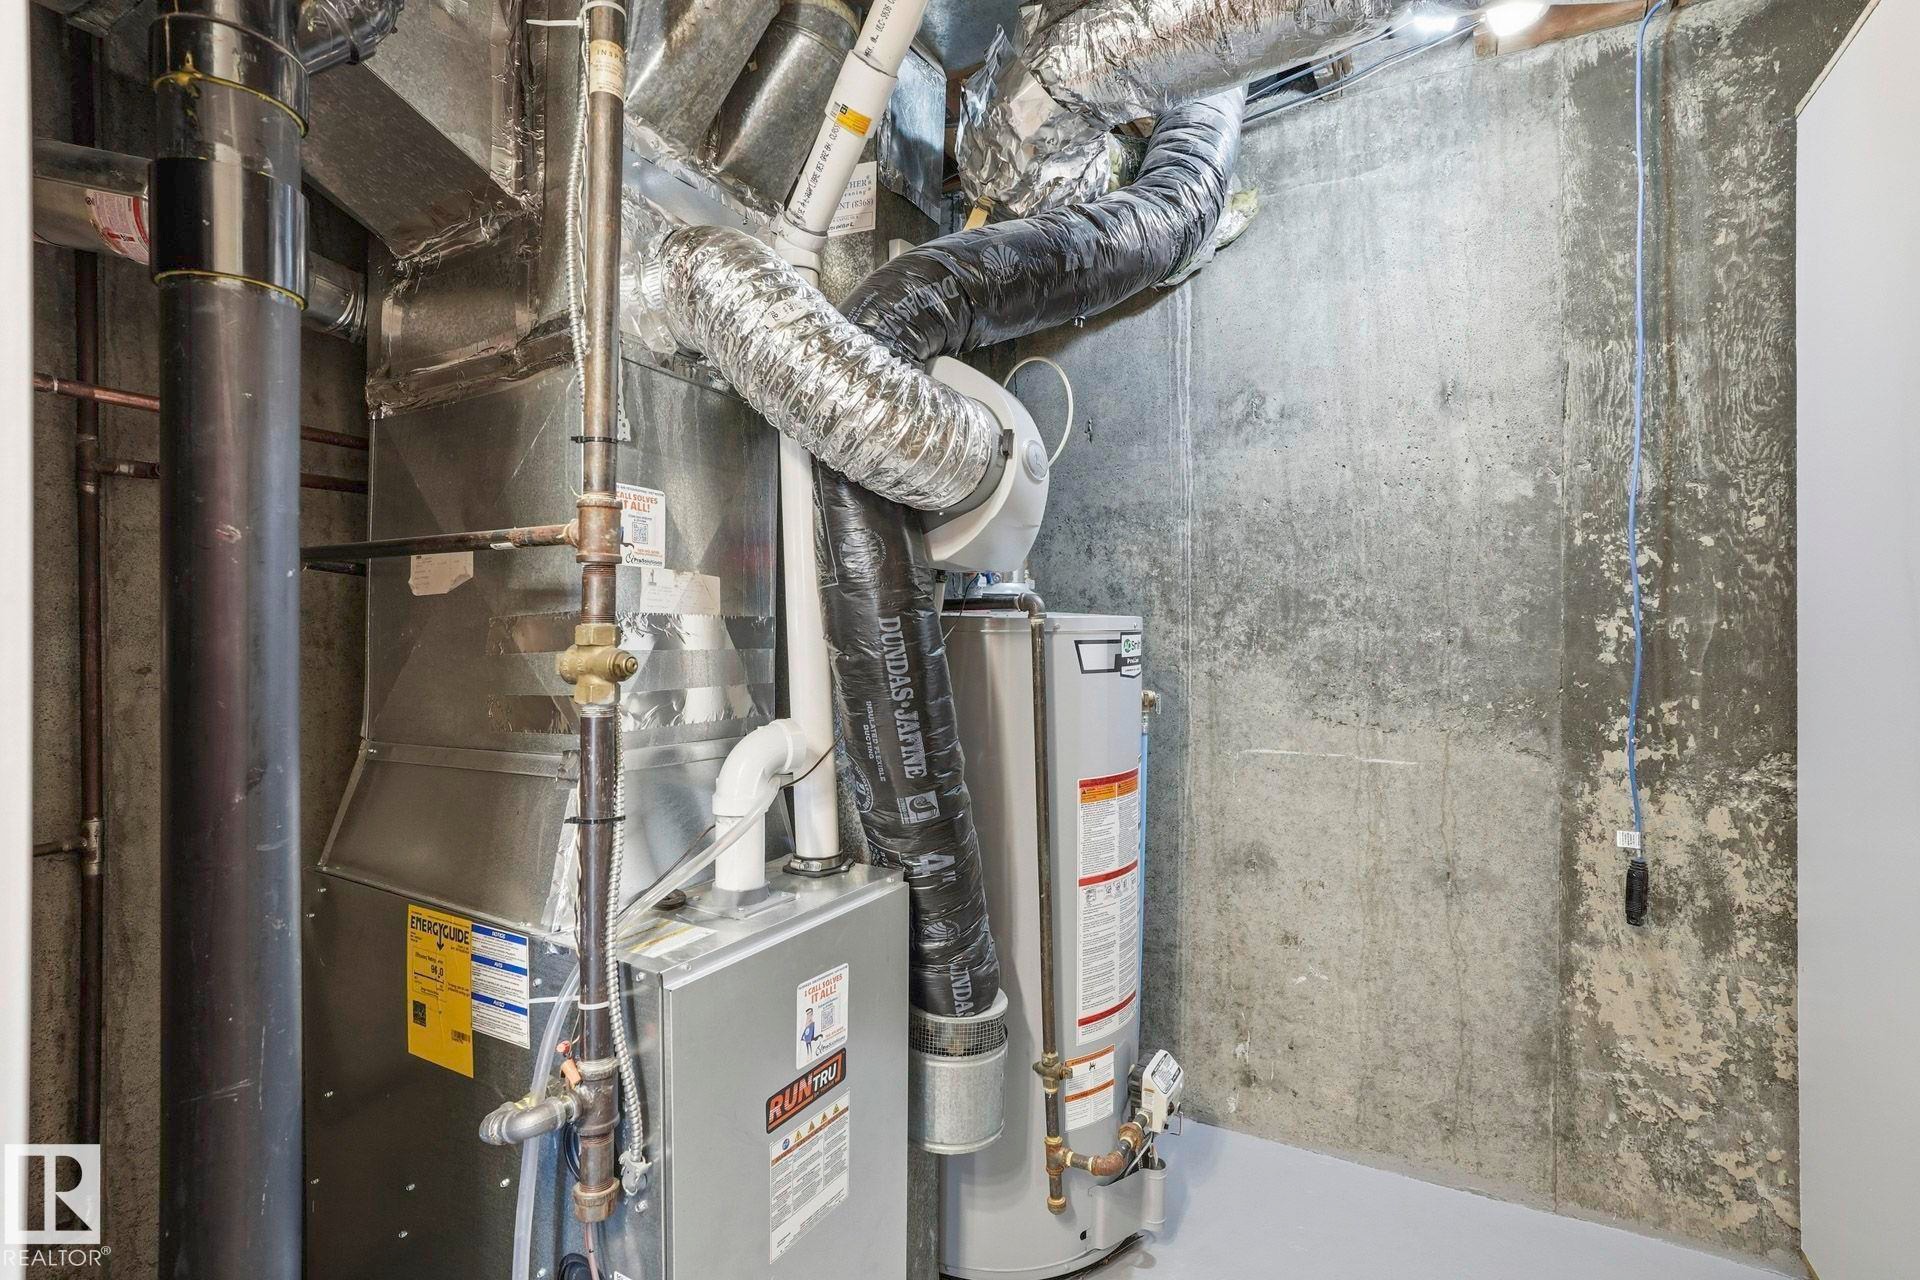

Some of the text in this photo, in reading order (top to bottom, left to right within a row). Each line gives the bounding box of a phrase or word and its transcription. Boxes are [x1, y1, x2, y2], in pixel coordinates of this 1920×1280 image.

[630, 501, 650, 513] ALL!
[633, 492, 658, 505] SOLVES
[878, 616, 914, 702] DUNDAS
[862, 724, 875, 760] DUCTING
[866, 700, 886, 782] INSULATED FLEXIBLE
[410, 915, 470, 945] ENERGYGUIDE
[808, 985, 821, 996] CALL
[822, 973, 843, 988] SOLVES
[811, 994, 819, 1004] IT
[820, 983, 837, 999] ALL!
